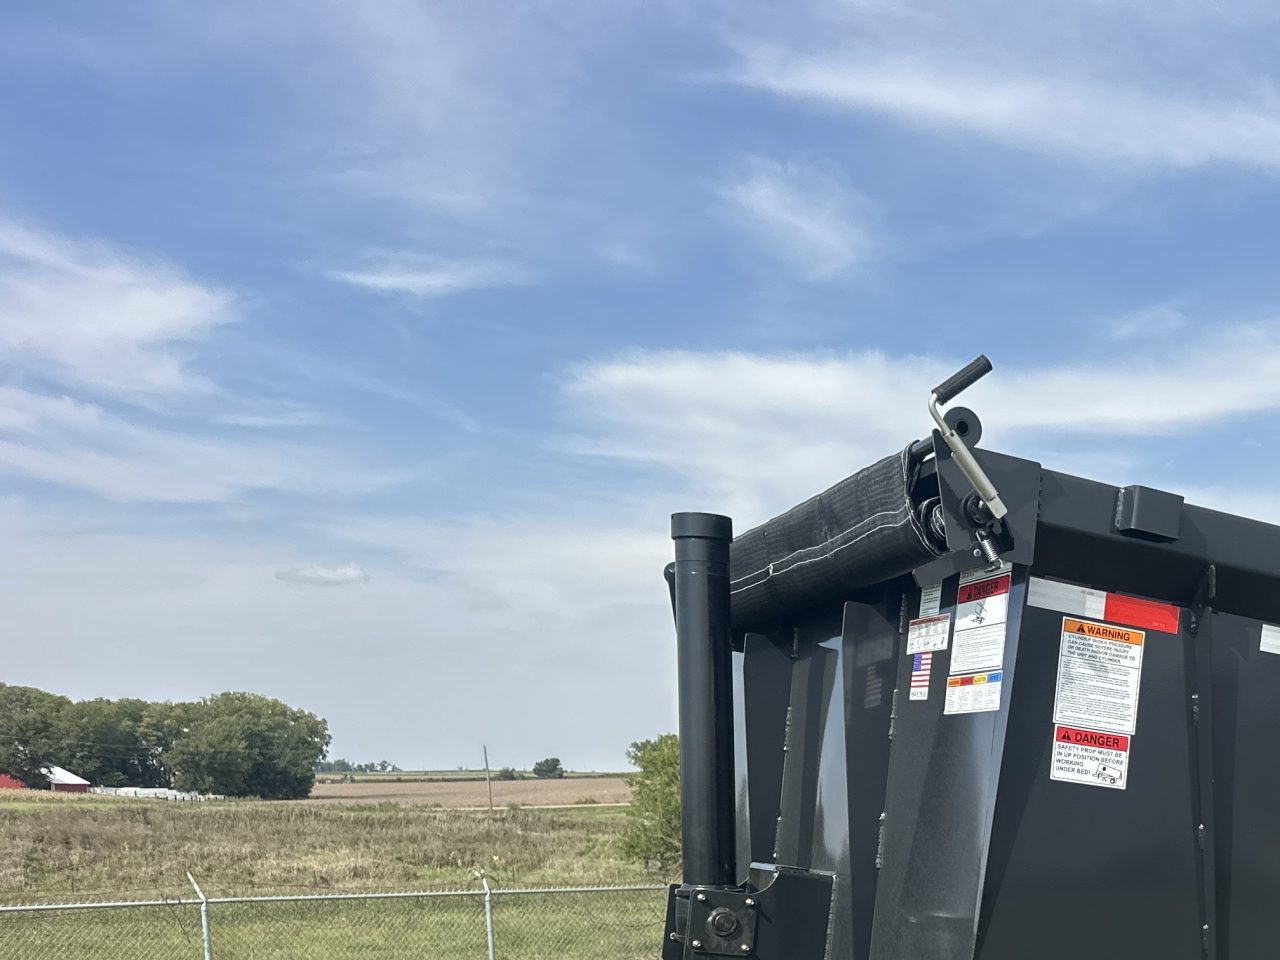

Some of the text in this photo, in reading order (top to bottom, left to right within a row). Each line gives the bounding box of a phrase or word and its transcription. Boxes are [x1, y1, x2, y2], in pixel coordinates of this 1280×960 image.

[1087, 626, 1130, 642] WARNING
[1109, 652, 1128, 660] DAMAGE
[1075, 732, 1120, 748] DANGER
[1057, 743, 1079, 751] SAFETY
[1098, 749, 1113, 757] MUST
[1056, 758, 1084, 767] WORKING
[1072, 753, 1100, 762] POSITION
[1100, 757, 1124, 766] BEFORE
[1055, 765, 1076, 773] UNDER
